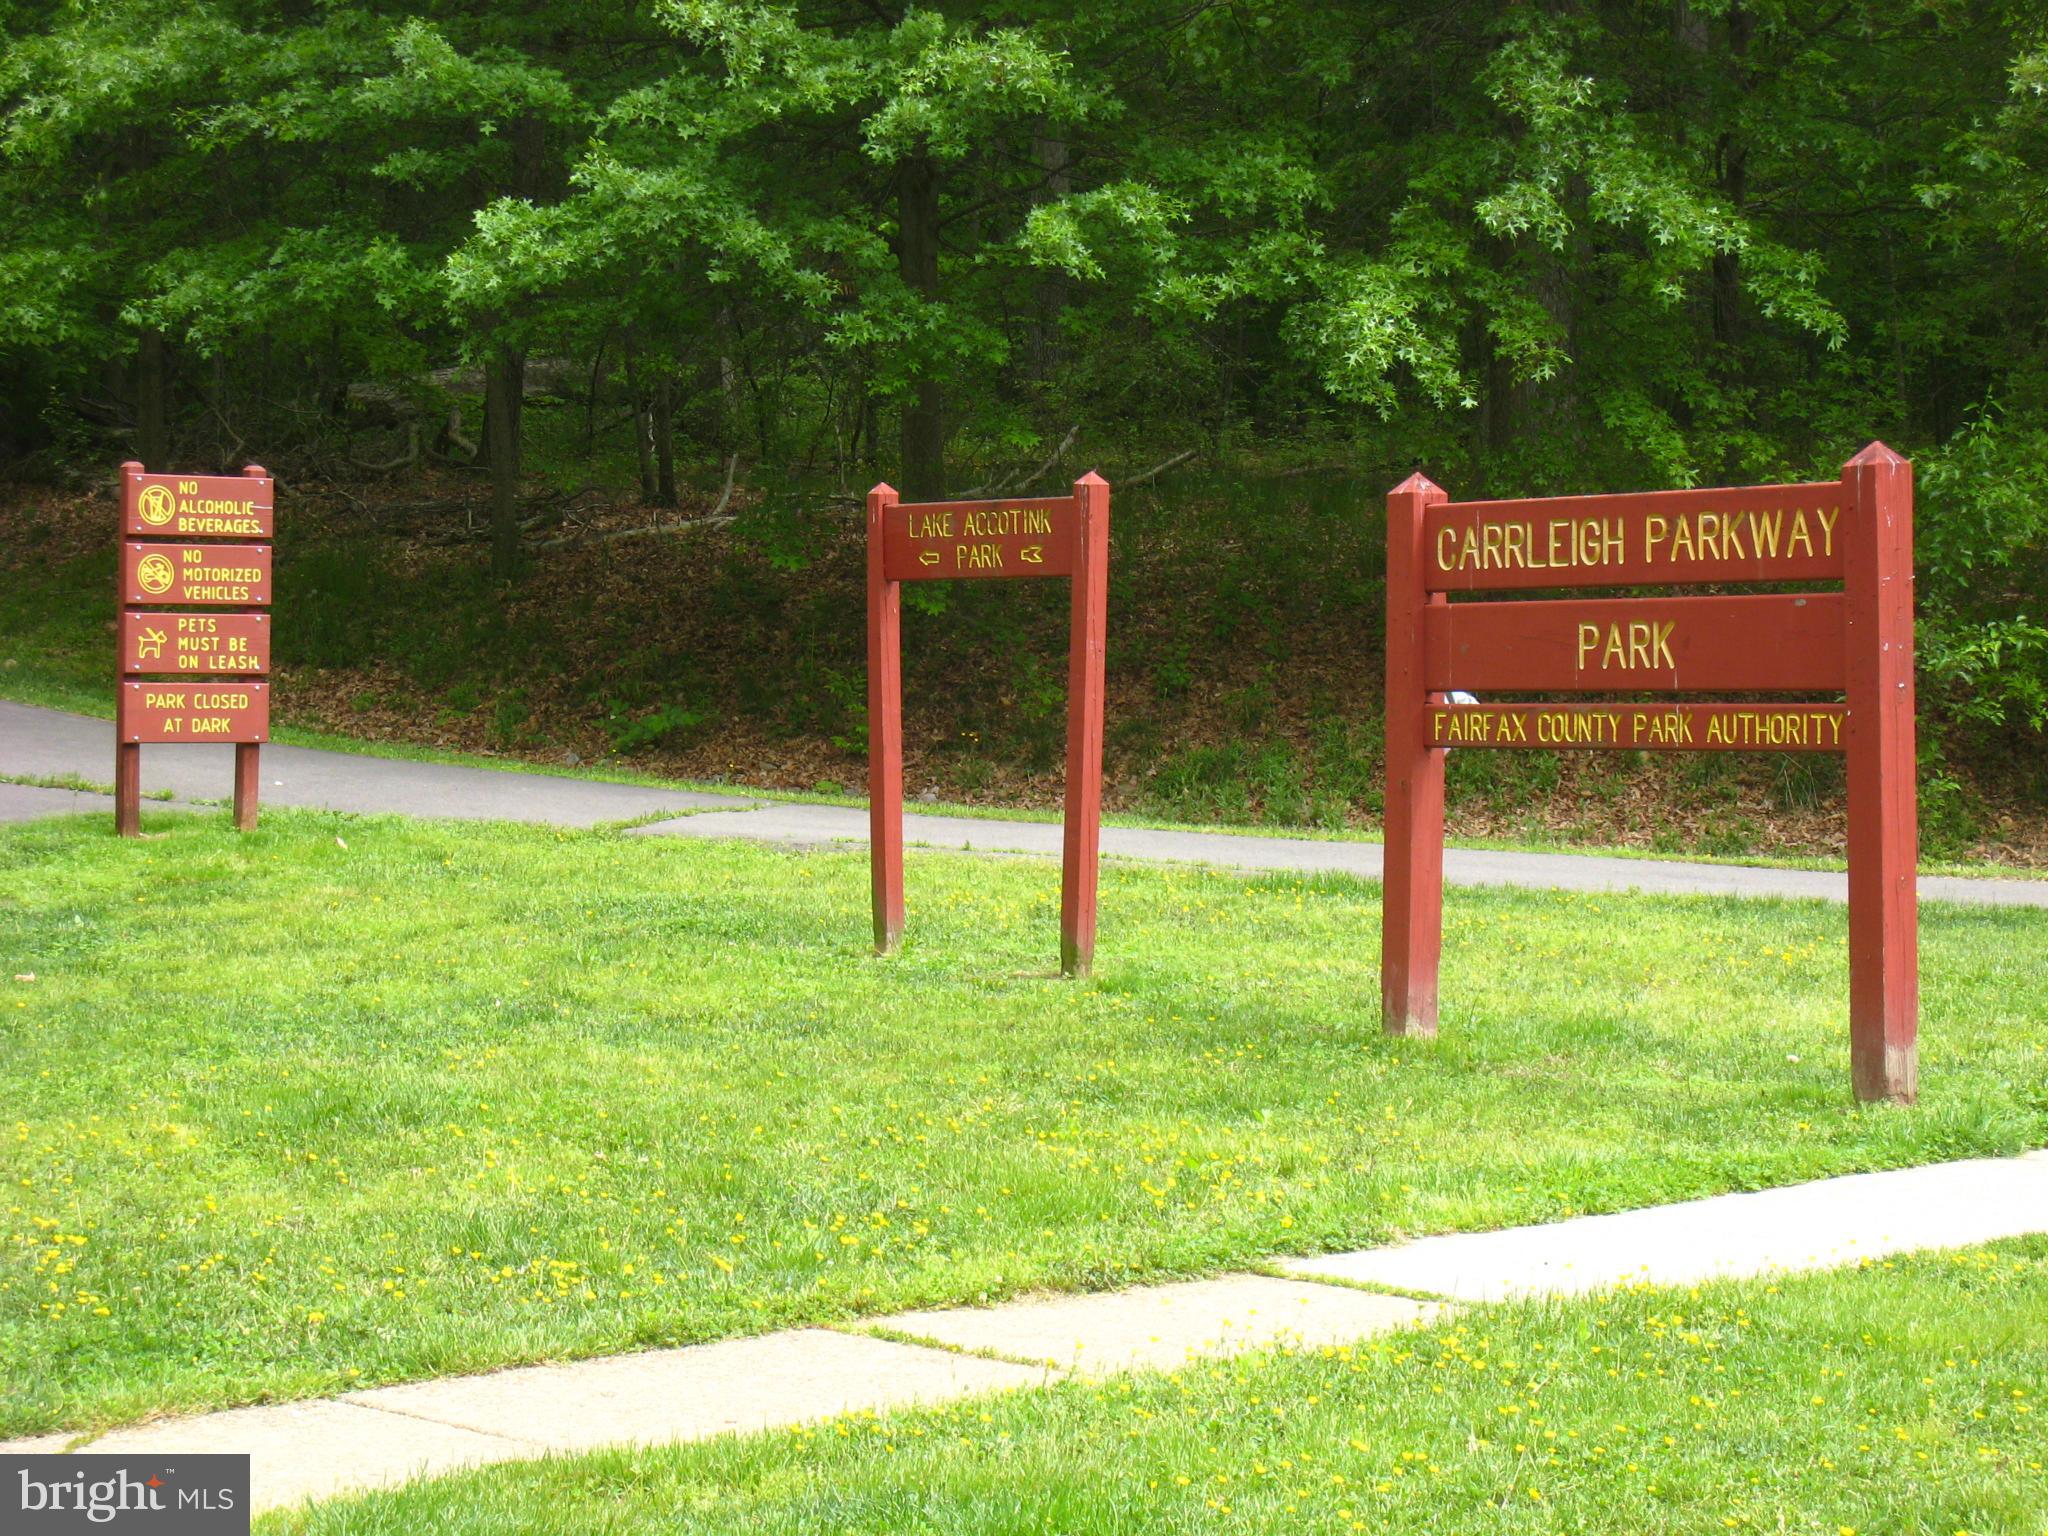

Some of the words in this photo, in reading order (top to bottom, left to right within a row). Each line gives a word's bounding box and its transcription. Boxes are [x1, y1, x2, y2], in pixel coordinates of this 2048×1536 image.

[179, 481, 198, 494] NO
[179, 500, 254, 514] ALCOHOLIC
[178, 519, 260, 533] BEVERAGES
[909, 513, 953, 538] LAKE
[964, 509, 1052, 536] ACCOTINK
[1437, 517, 1625, 571] CARRLEIGH
[1645, 506, 1840, 562] PARKWAY
[183, 550, 201, 563] NO
[957, 544, 1003, 569] PARK
[183, 568, 261, 582] MOTORIZED
[184, 586, 249, 600] VEHICLES
[178, 619, 216, 632] PETS
[178, 637, 218, 651] MUST
[230, 638, 247, 651] BE
[1578, 621, 1676, 670] PARK
[179, 656, 198, 668] ON
[210, 656, 259, 669] LEASH
[146, 694, 185, 708] PARK
[194, 694, 248, 709] CLOSED
[164, 718, 183, 732] AT
[192, 718, 230, 732] DARK
[1433, 712, 1528, 742] FAIRFAX
[1537, 712, 1622, 743] COUNTY
[1633, 712, 1693, 743] PARK
[1706, 712, 1844, 745] AUTHORITY
